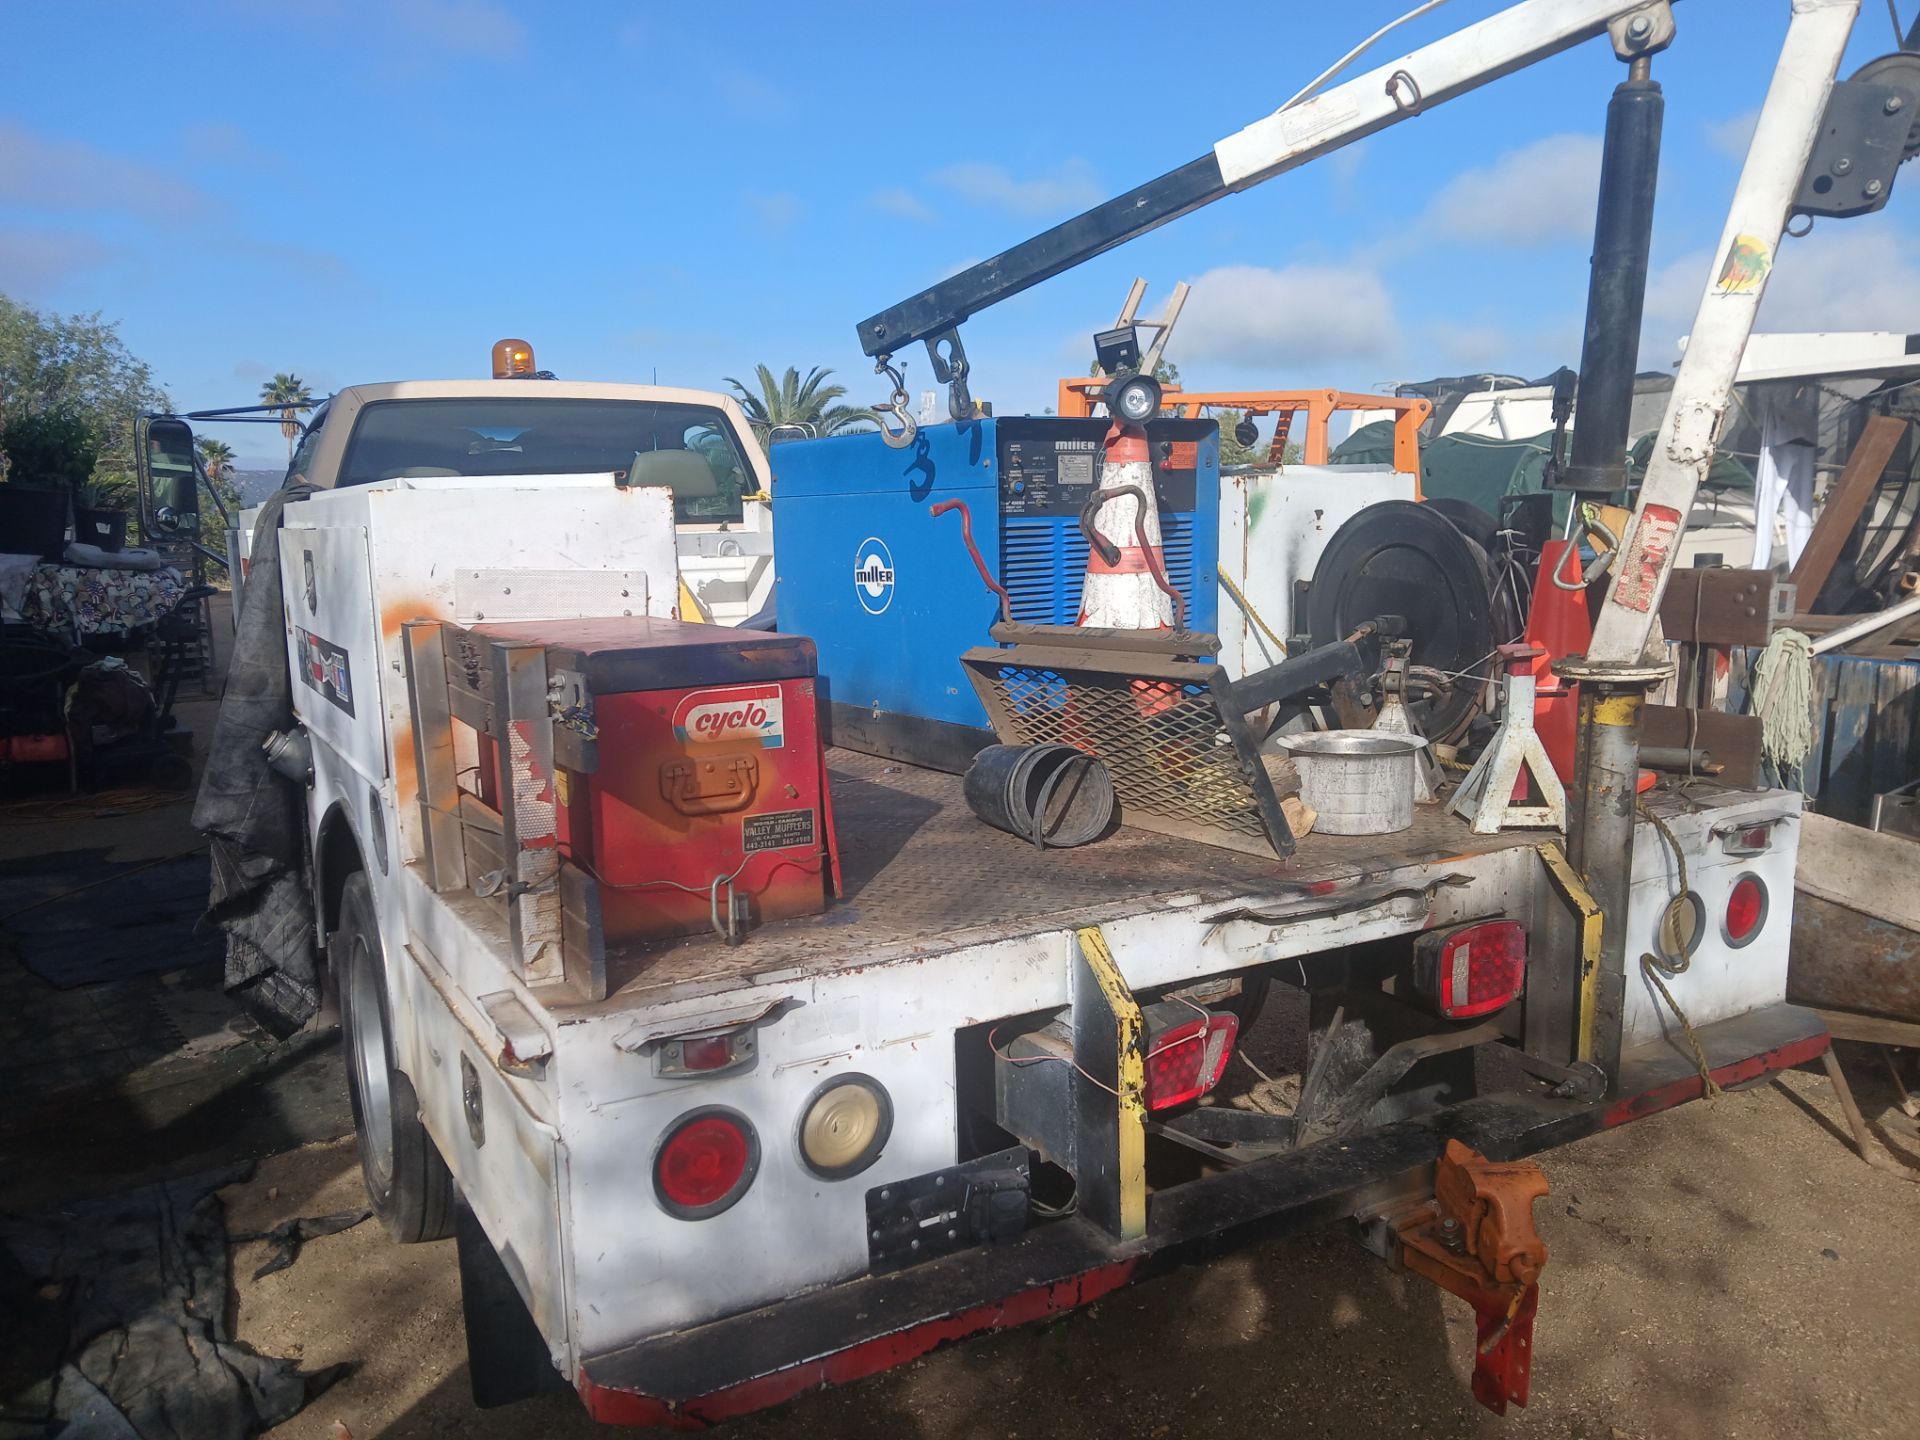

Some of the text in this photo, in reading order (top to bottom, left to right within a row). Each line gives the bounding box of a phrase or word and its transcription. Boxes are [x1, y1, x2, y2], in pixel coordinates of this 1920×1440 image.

[695, 702, 767, 739] cyclo
[744, 821, 812, 837] VALLEY MUFFLERS
